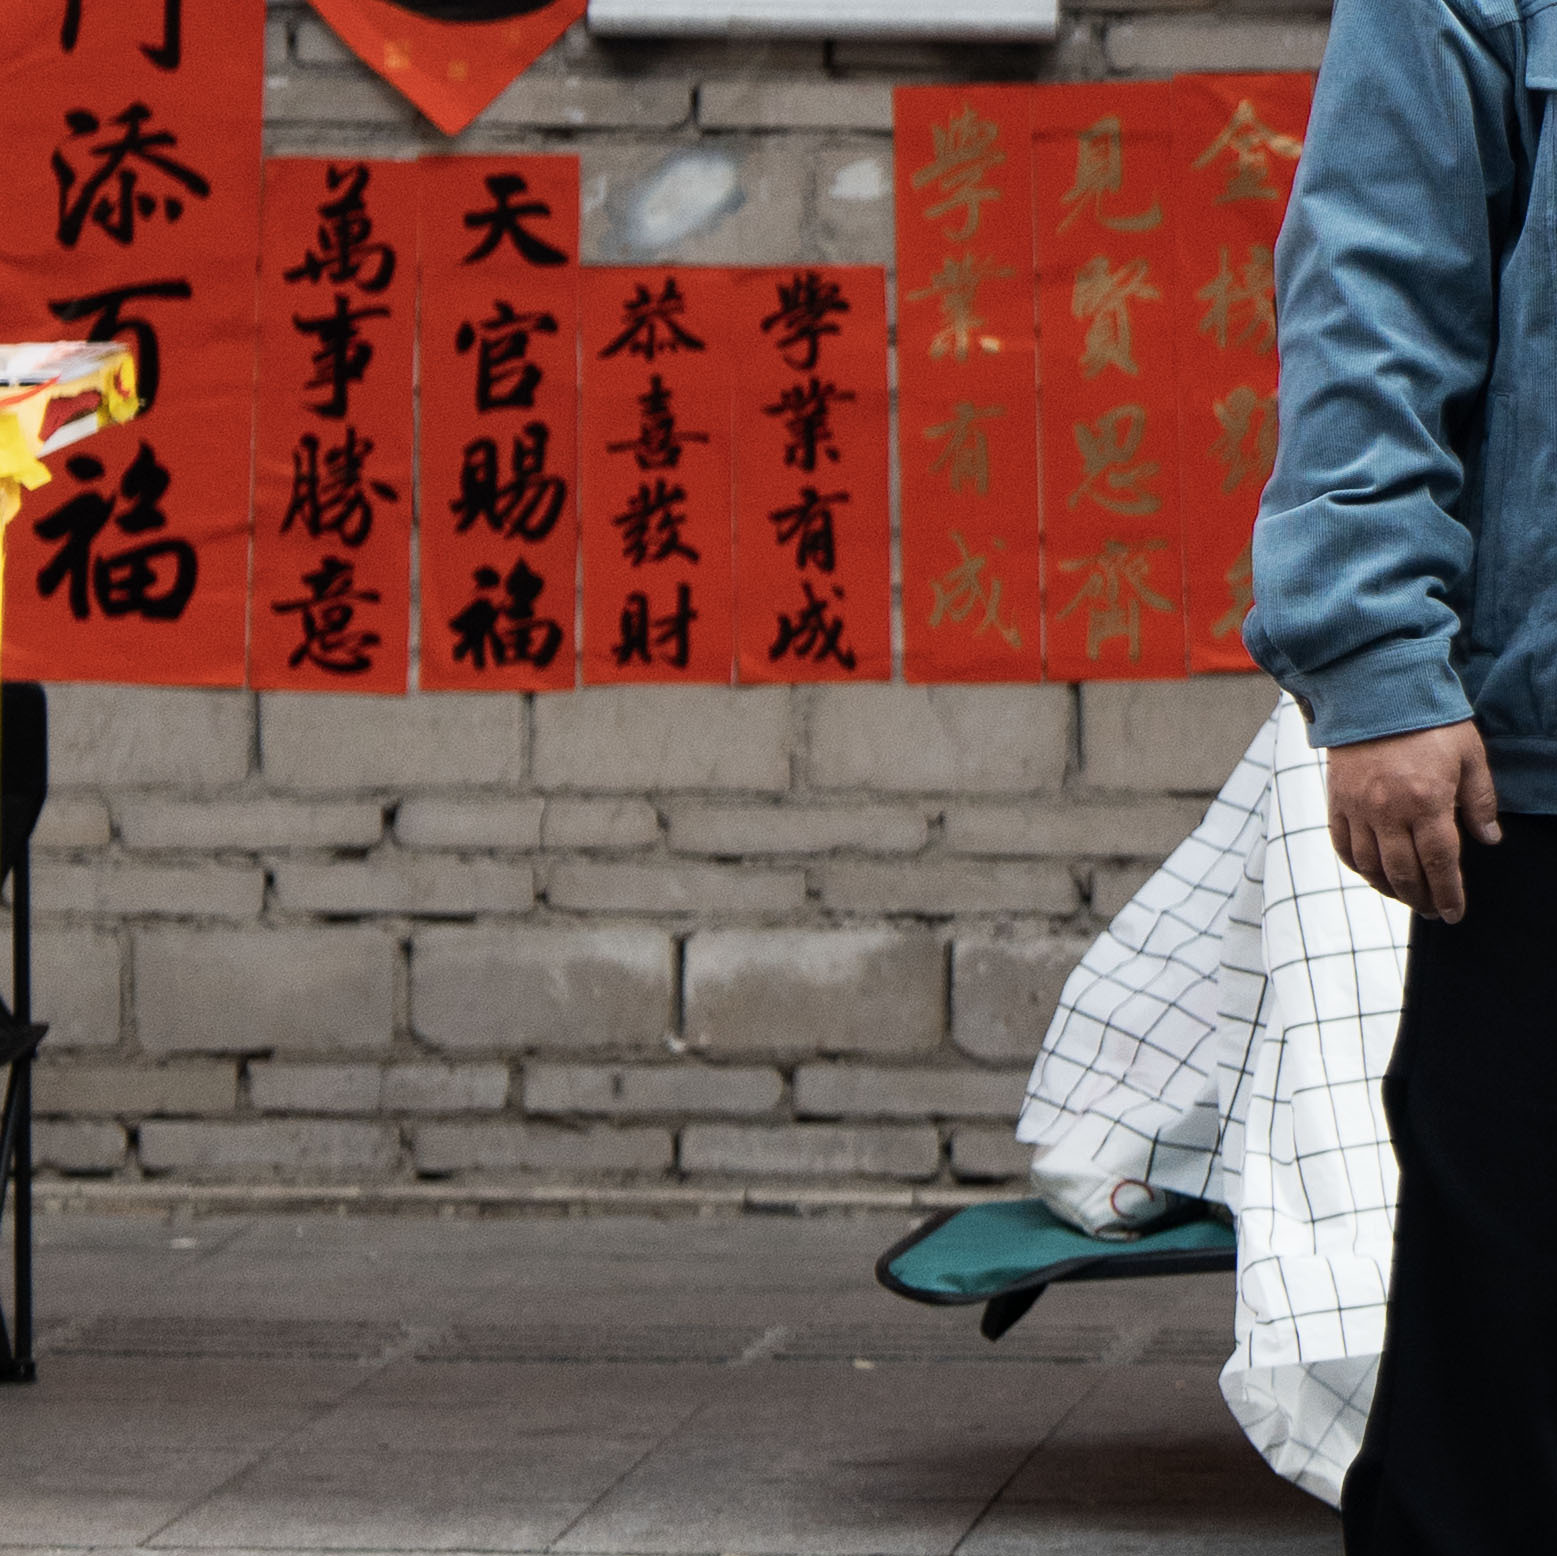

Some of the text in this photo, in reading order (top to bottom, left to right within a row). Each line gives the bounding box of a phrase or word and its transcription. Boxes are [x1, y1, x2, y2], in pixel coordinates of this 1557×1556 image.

[273, 164, 398, 674] 萬事勝意
[449, 174, 568, 671] 天官賜福
[601, 278, 709, 670] 恭喜發財
[761, 272, 856, 671] 學業有成
[907, 102, 1021, 651] 學業有成
[1056, 115, 1174, 662] 見賢思齊
